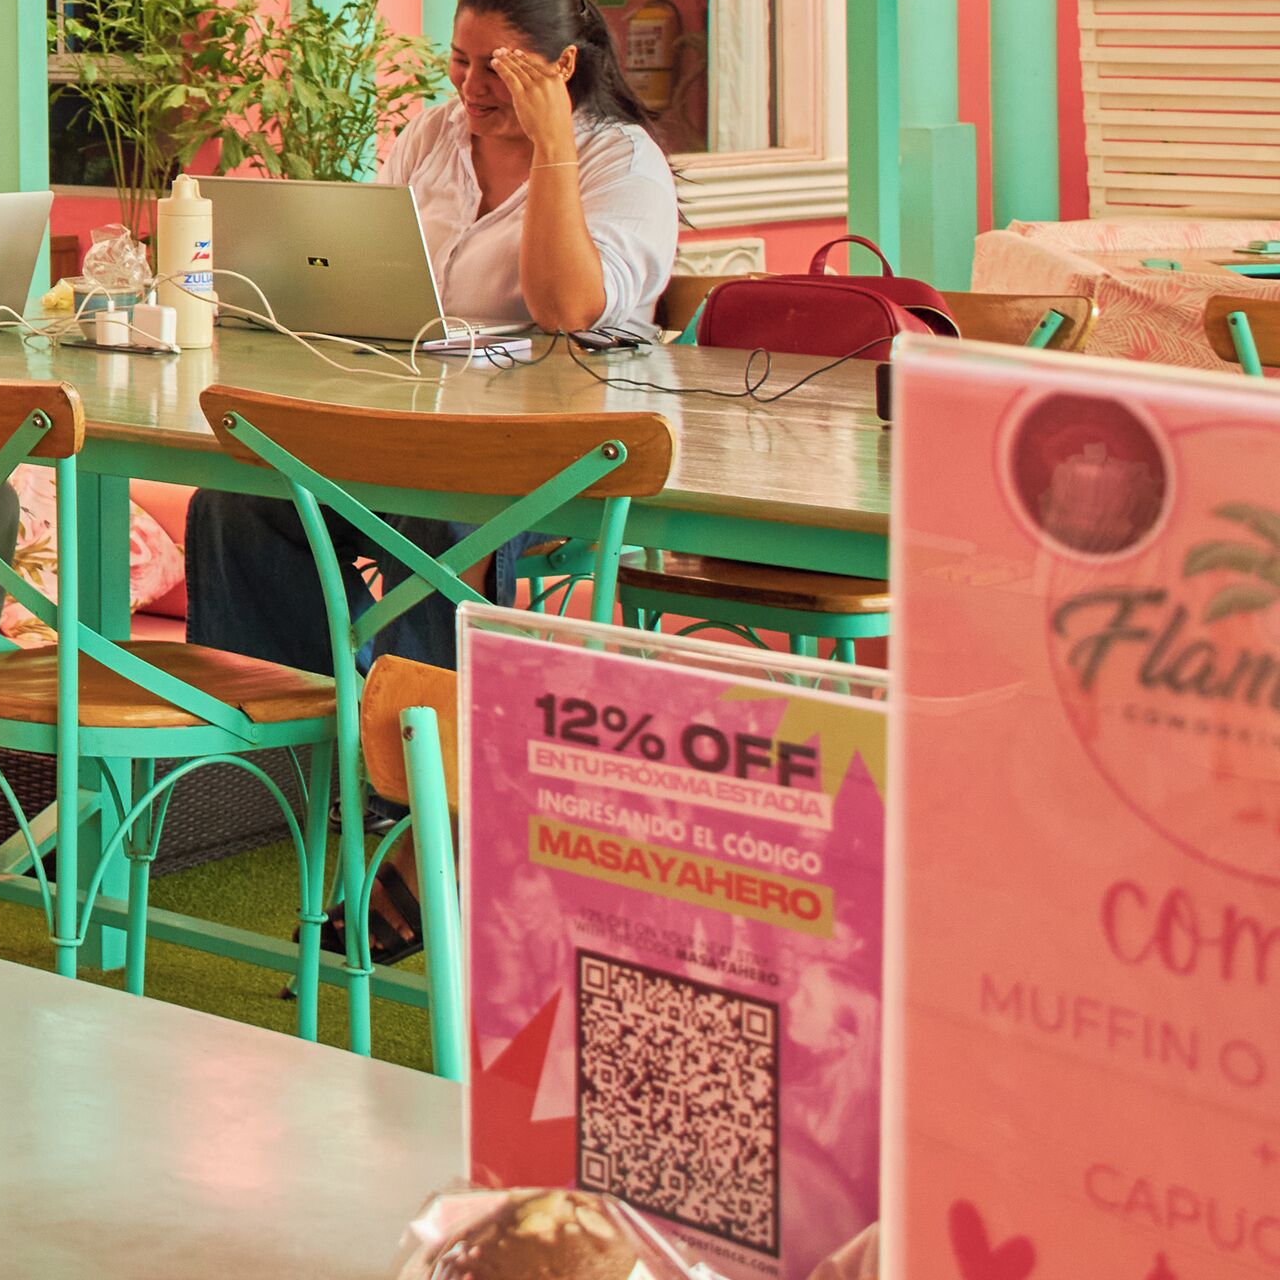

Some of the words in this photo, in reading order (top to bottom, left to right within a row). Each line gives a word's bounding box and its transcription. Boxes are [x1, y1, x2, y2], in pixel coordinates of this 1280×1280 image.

[535, 692, 666, 761] 12%
[680, 723, 817, 787] OFF
[538, 787, 686, 842] INGRESANDO
[693, 825, 716, 851] EL
[723, 831, 822, 875] CÓDIGO
[538, 824, 822, 921] MASAYAHERO
[979, 971, 1200, 1073] MUFFIN
[1218, 1038, 1268, 1090] O
